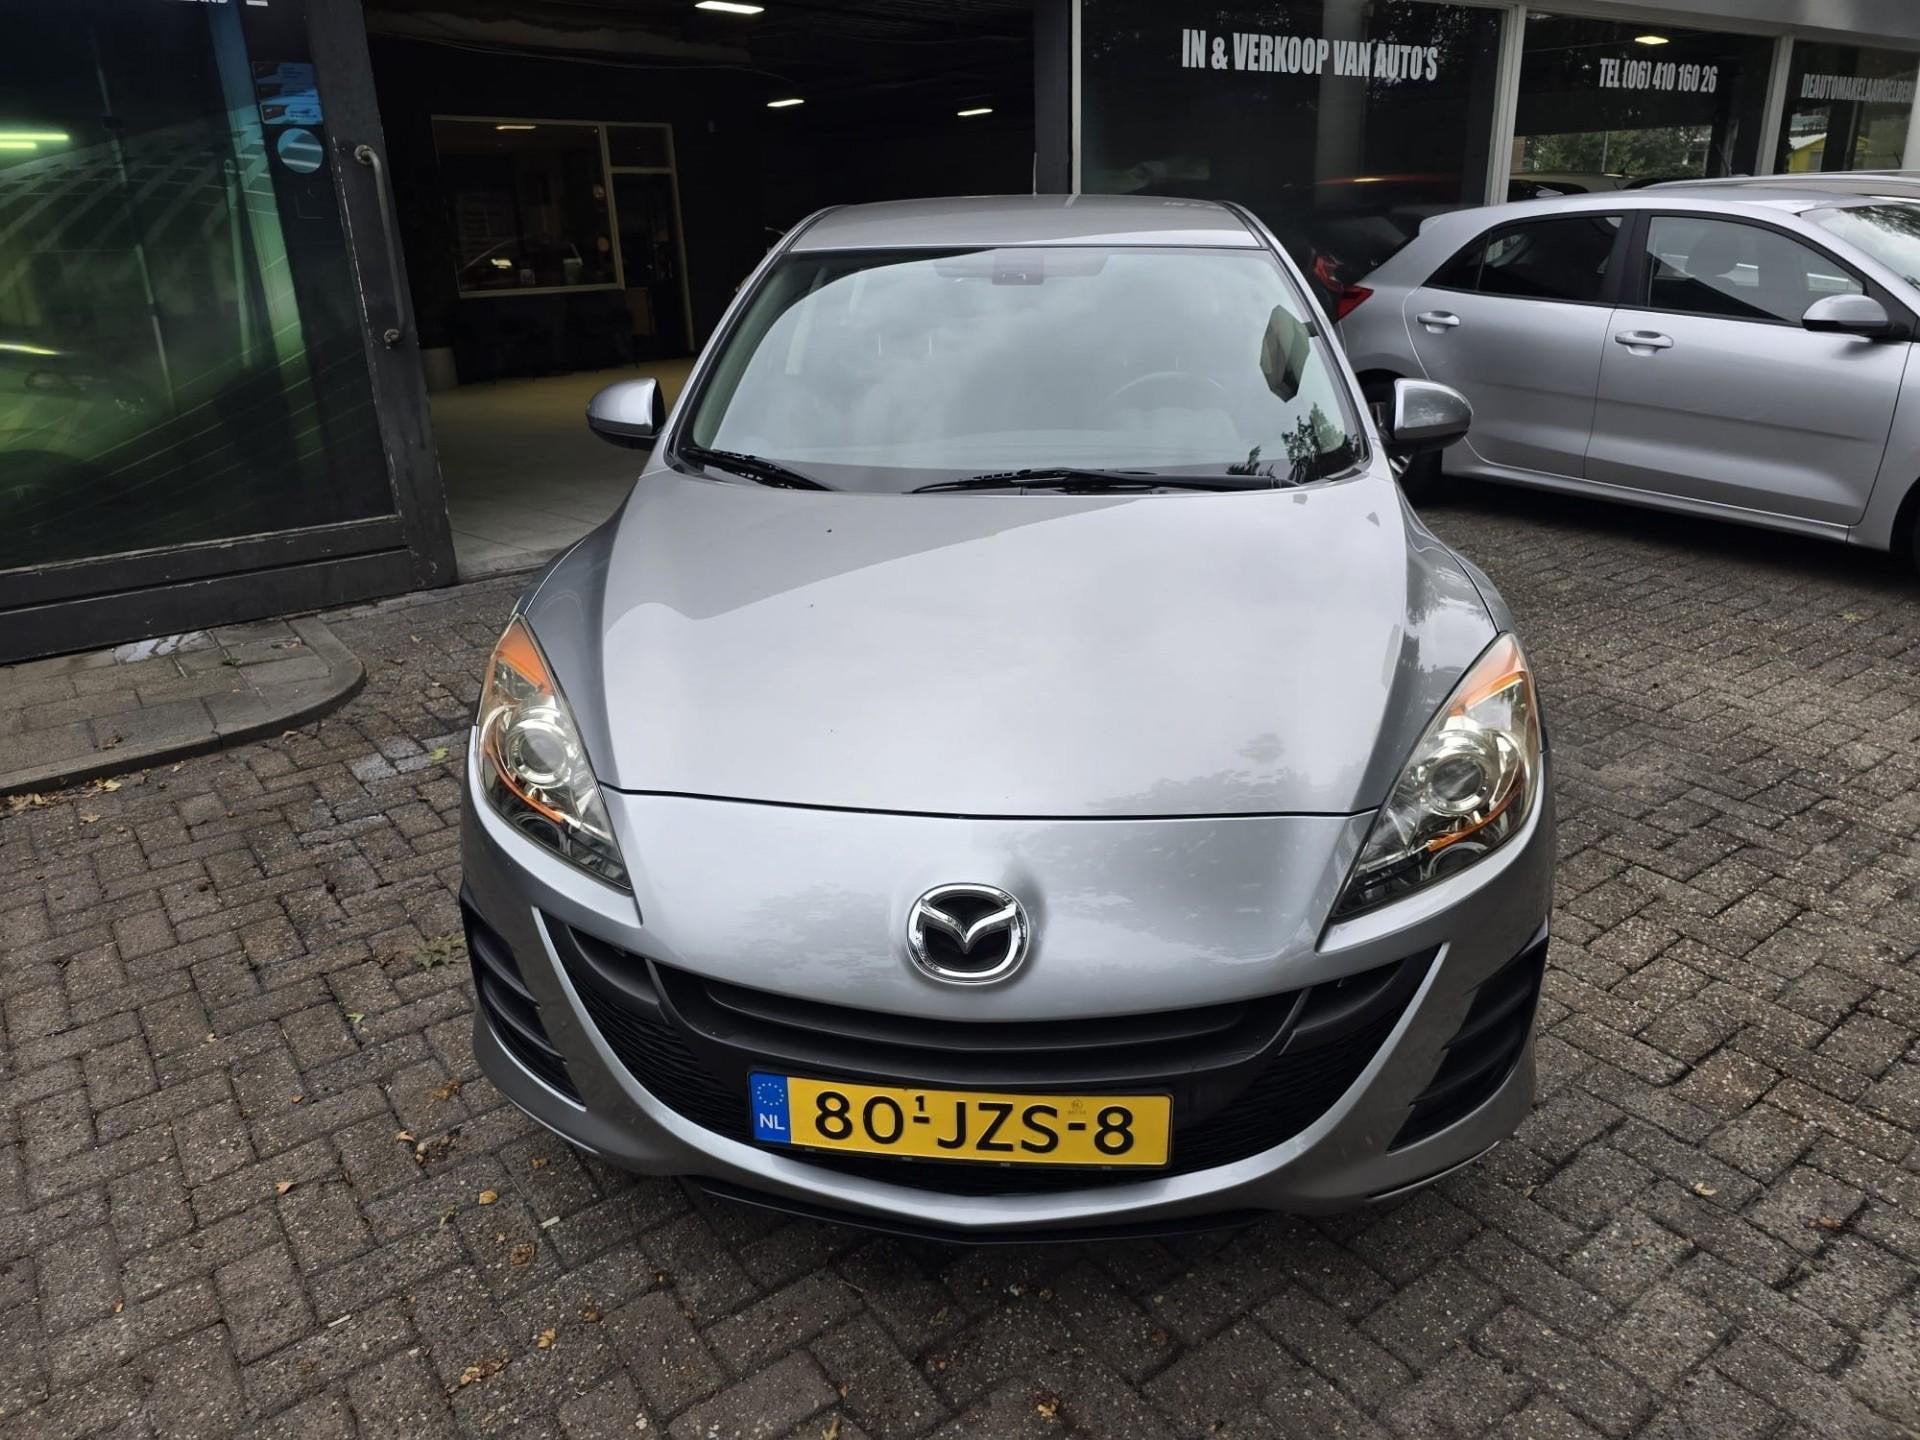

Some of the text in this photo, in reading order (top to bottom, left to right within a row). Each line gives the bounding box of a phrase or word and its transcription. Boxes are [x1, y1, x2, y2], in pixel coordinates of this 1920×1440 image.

[1182, 29, 1438, 82] IN & VERKOOP VAN AUTO'S
[1599, 58, 1718, 93] TEL (06) 410 160 26
[759, 1112, 786, 1131] NL
